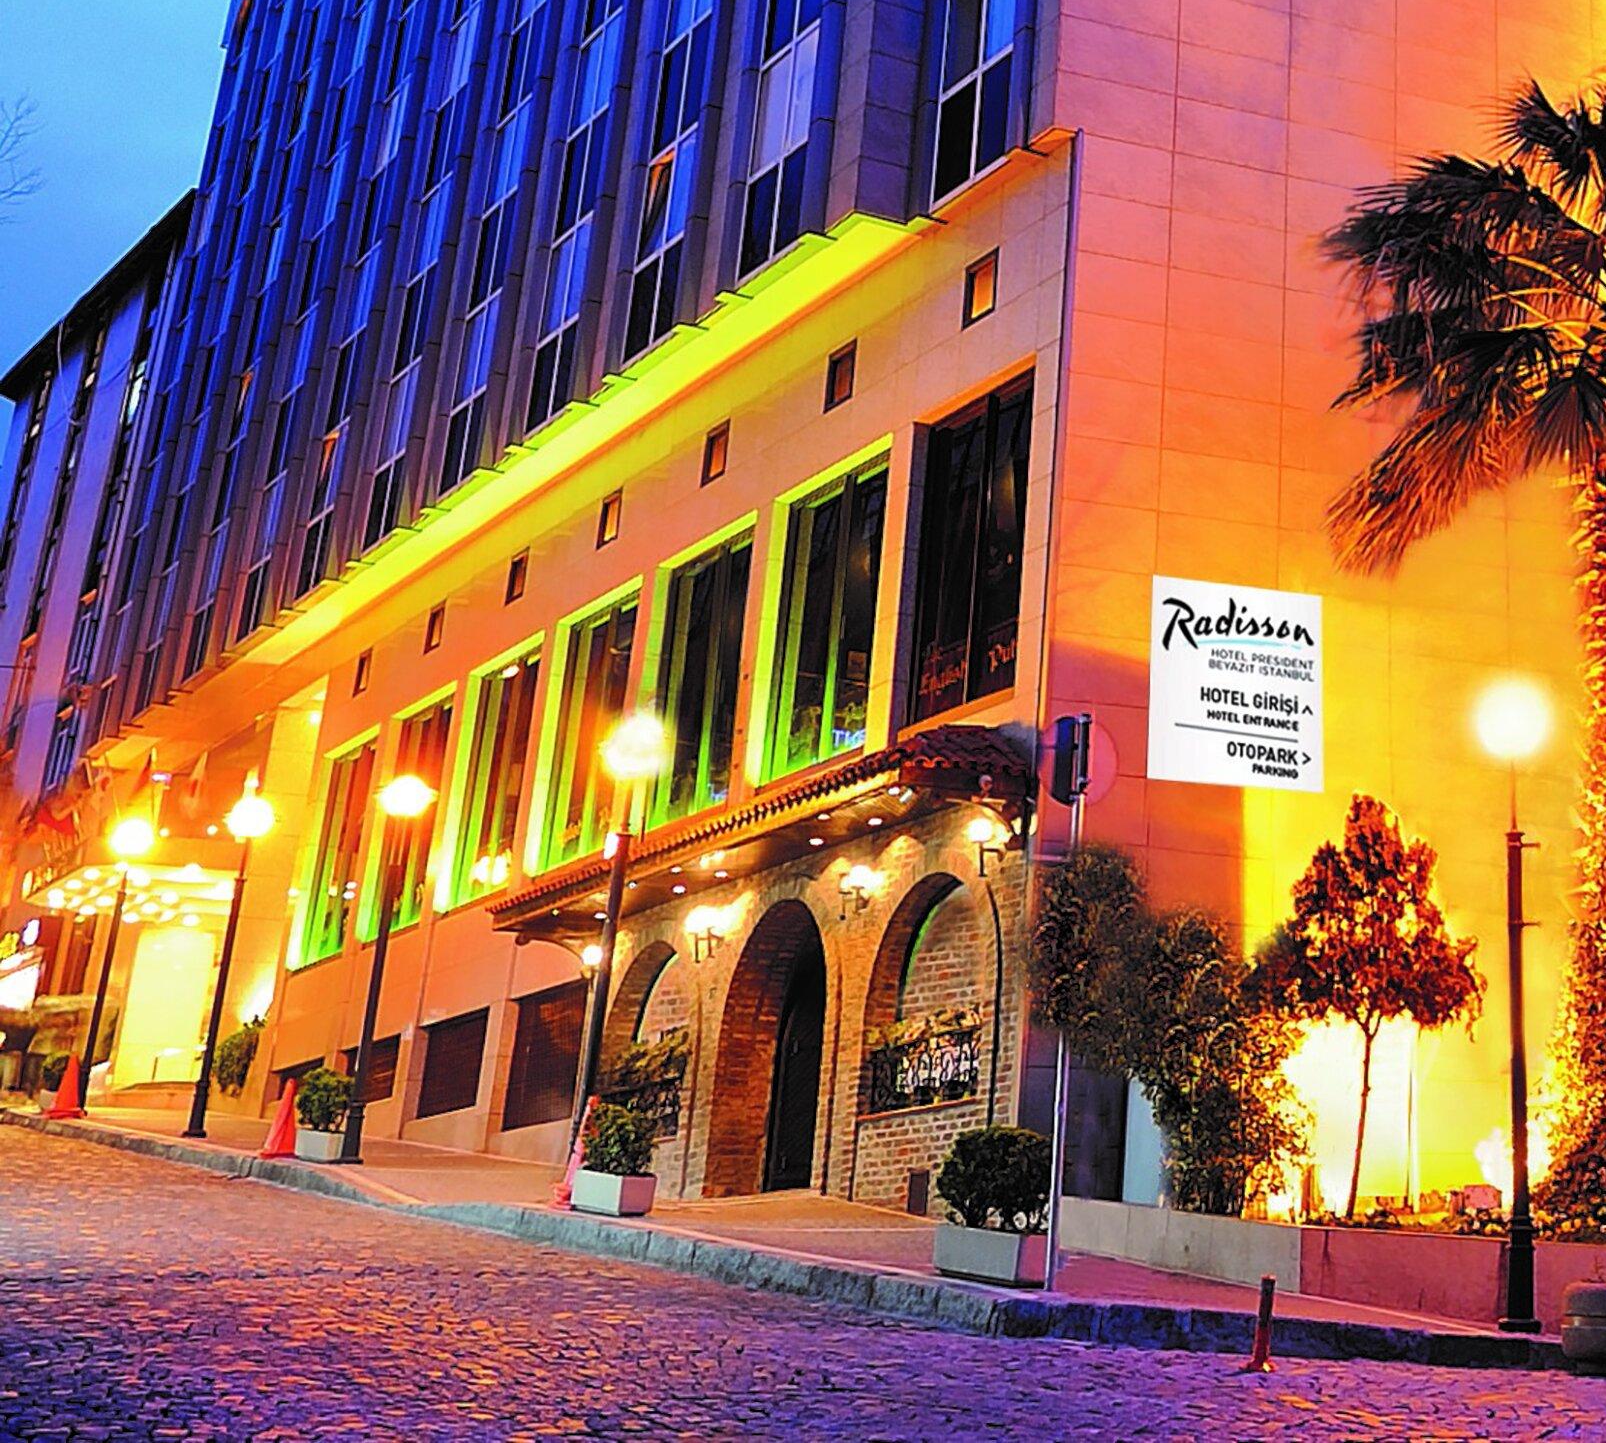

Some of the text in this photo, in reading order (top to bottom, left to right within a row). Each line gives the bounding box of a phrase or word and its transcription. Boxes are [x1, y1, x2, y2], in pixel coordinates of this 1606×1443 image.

[1162, 597, 1315, 651] Radisson
[1211, 648, 1315, 671] HOTEL PRESIDENT
[1200, 686, 1299, 717] HOTEL GİRİŞİ
[1206, 709, 1299, 733] HOTEL ENTRANCE
[1226, 740, 1298, 766] OTOPARK
[1252, 762, 1299, 780] PARKING
